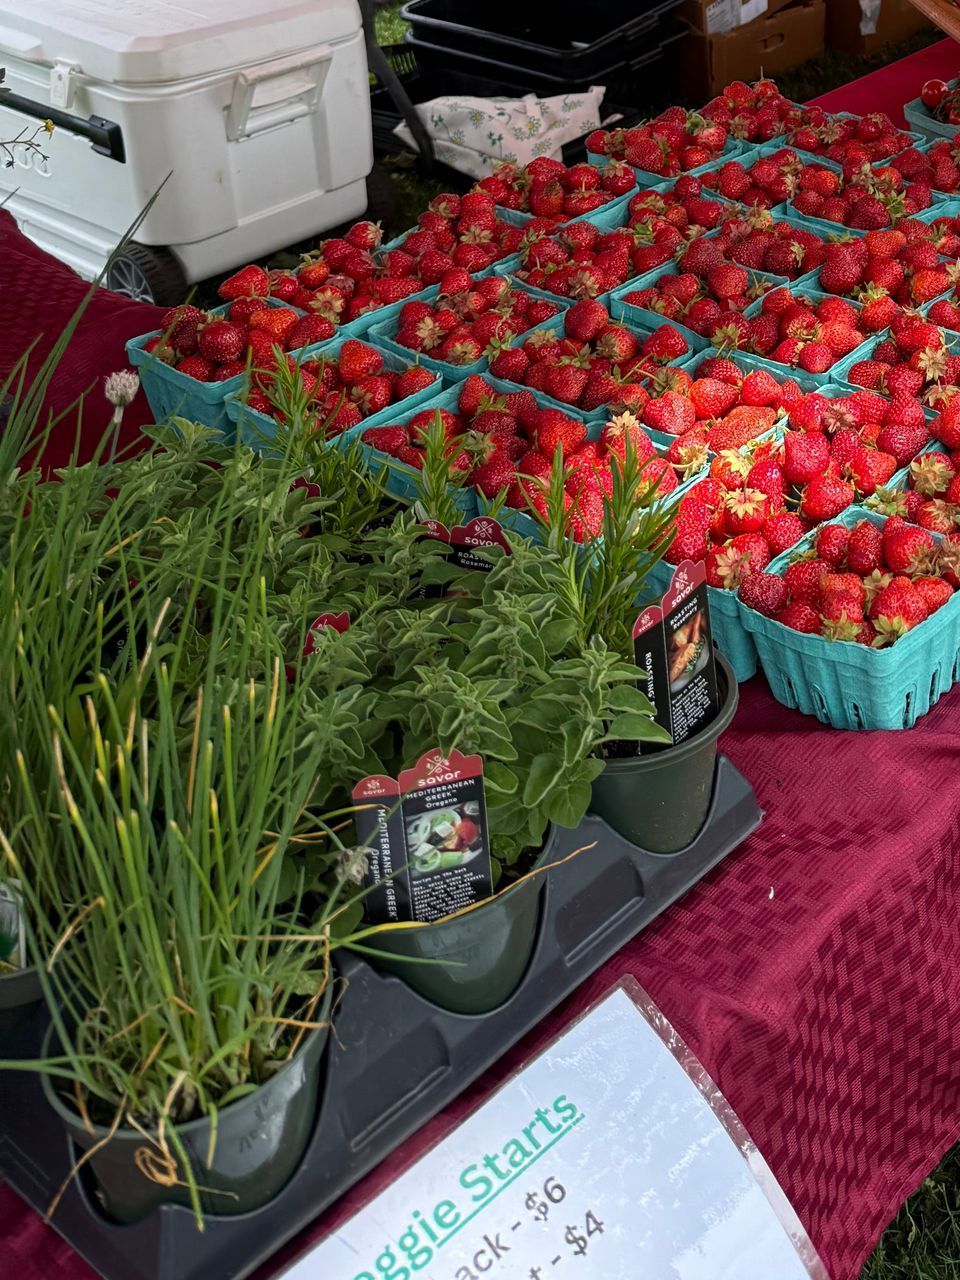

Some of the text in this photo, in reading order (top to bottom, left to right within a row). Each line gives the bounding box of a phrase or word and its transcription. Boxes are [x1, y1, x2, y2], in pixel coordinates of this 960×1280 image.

[671, 582, 694, 608] savor
[406, 779, 475, 800] MEDITERRANEAN
[418, 770, 461, 787] savor
[426, 797, 458, 809] Oregano
[377, 809, 394, 887] MEDITERRANEN
[459, 1094, 578, 1201] Starts
[525, 1176, 566, 1222] $6
[564, 1209, 604, 1256] $4
